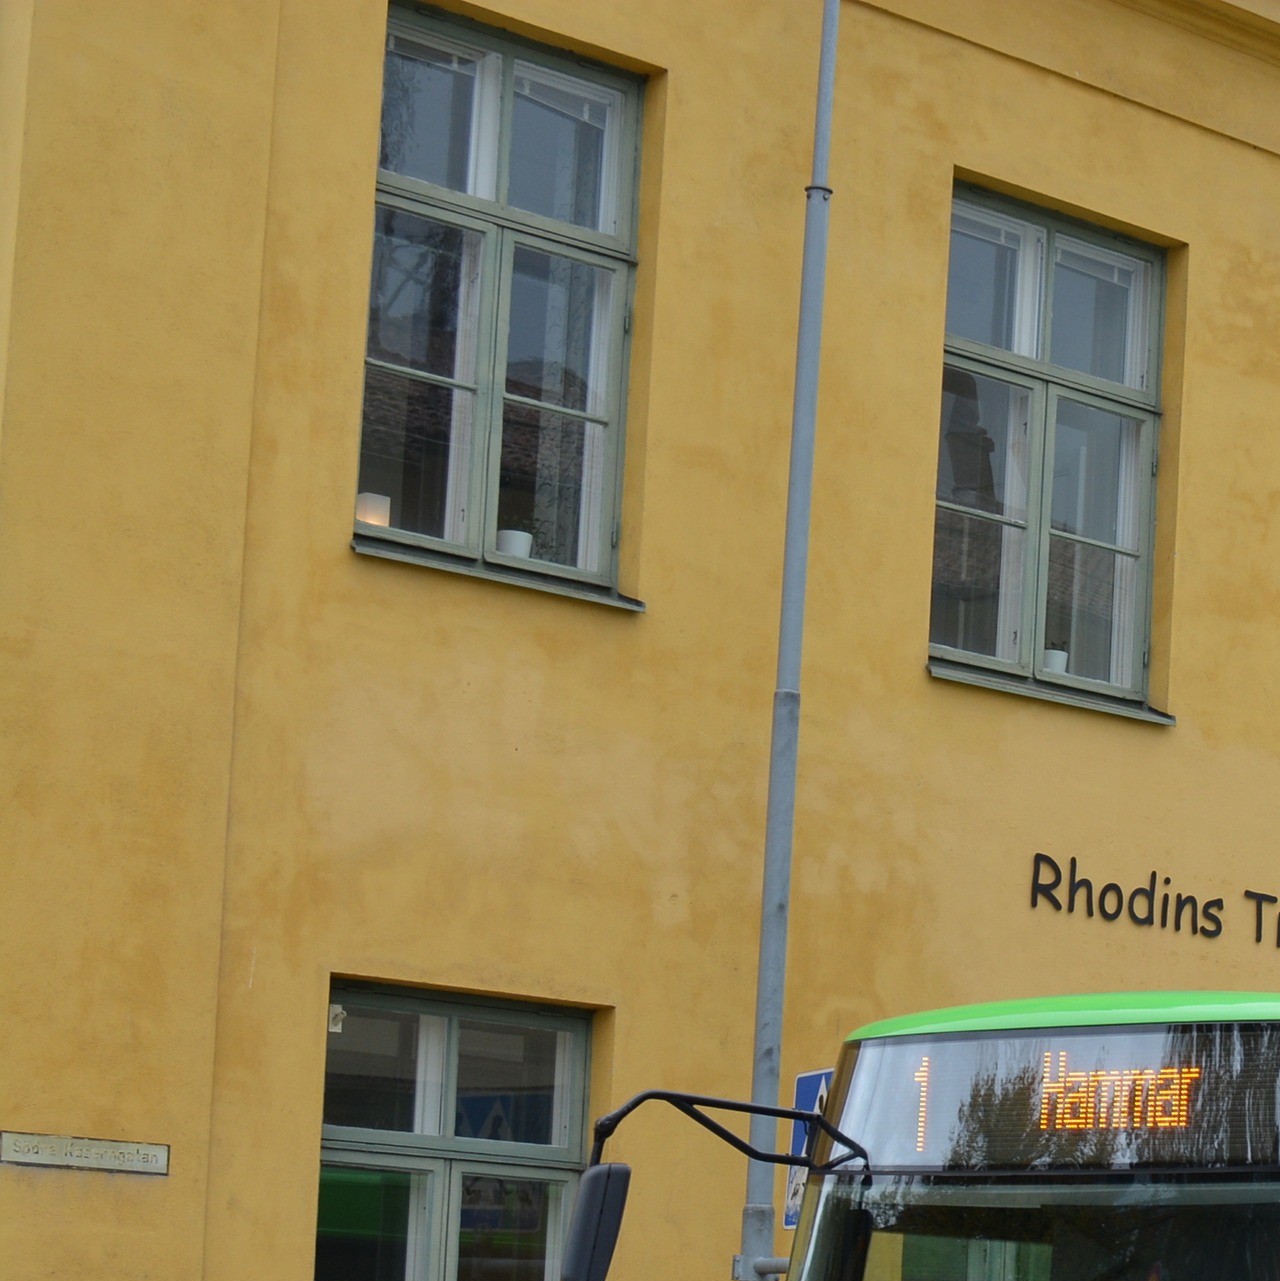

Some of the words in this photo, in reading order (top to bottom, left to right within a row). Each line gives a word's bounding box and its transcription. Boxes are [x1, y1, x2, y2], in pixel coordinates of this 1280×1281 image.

[1031, 852, 1224, 938] Rhodins
[914, 1056, 931, 1152] 1
[1040, 1051, 1200, 1130] Hammar
